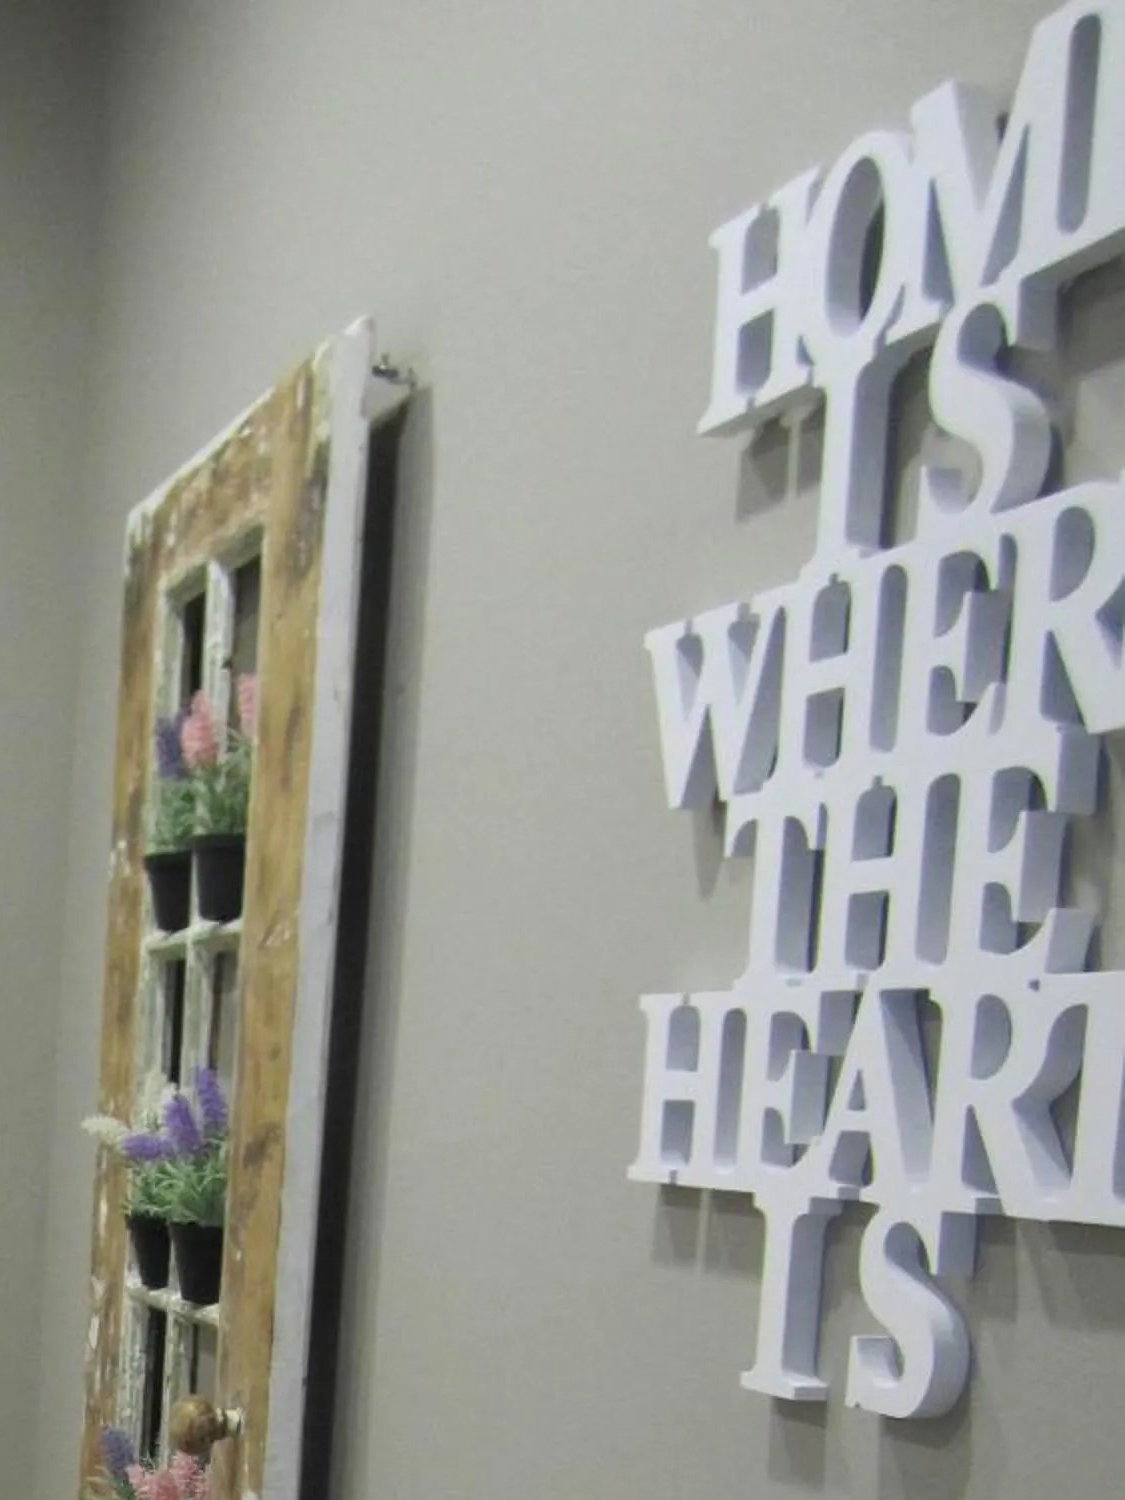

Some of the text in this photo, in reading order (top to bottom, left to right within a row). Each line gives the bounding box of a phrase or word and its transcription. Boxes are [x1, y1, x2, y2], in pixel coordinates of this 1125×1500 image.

[799, 285, 1040, 580] IS
[725, 742, 1065, 990] THE
[740, 1193, 967, 1418] IS
